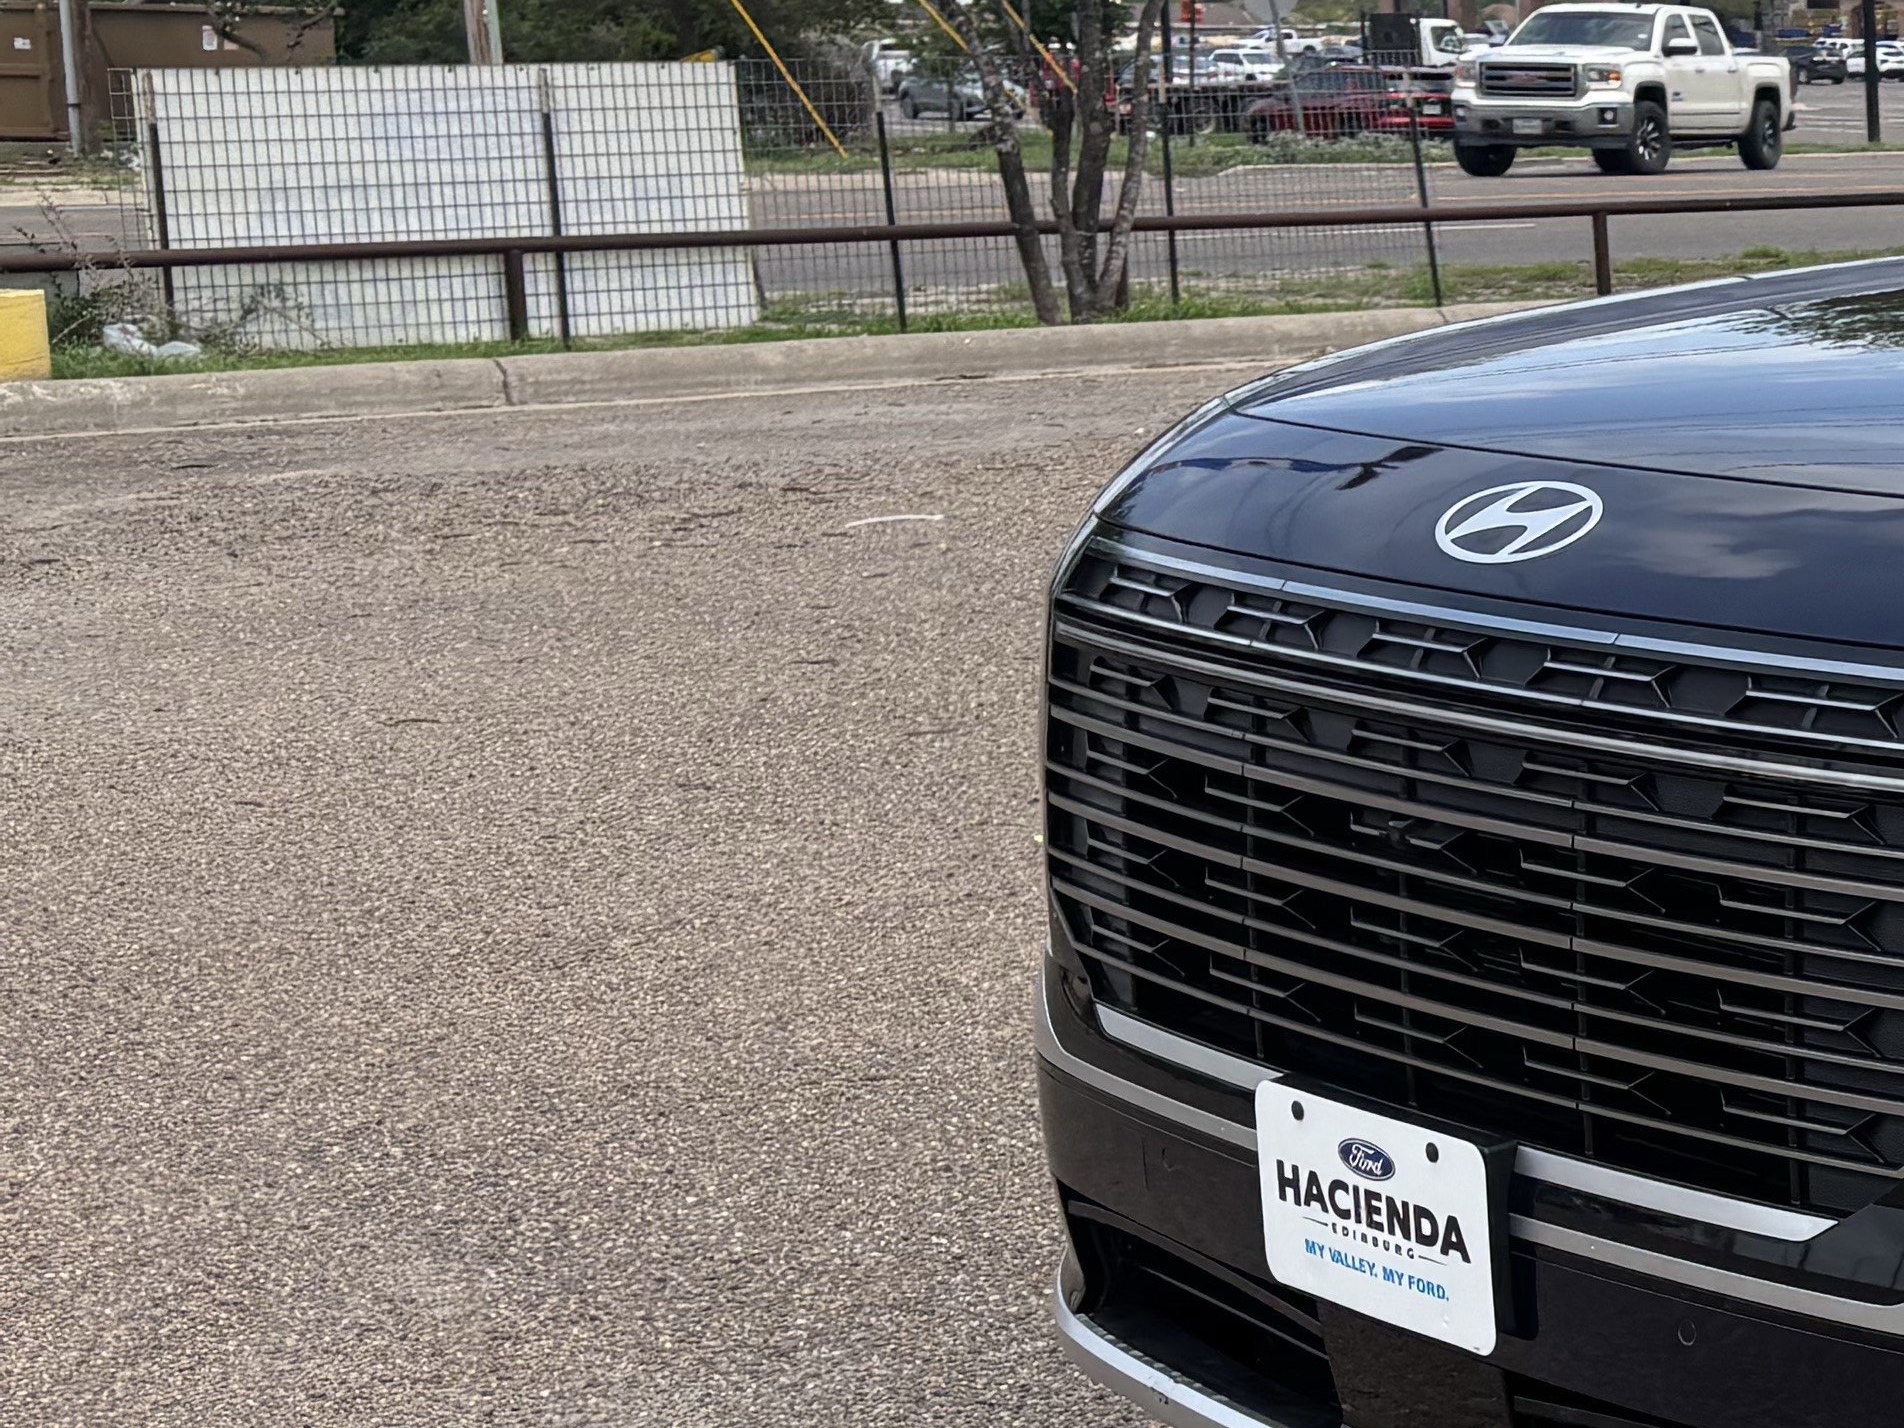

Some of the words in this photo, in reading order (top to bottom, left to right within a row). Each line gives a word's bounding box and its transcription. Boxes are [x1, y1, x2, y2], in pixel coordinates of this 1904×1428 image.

[1349, 1144, 1385, 1176] Ford
[1276, 1158, 1472, 1264] HACIENDA
[1304, 1238, 1325, 1260] MY
[1328, 1247, 1378, 1278] VALLEY.
[1382, 1266, 1404, 1287] MY
[1407, 1275, 1450, 1302] FORD.
